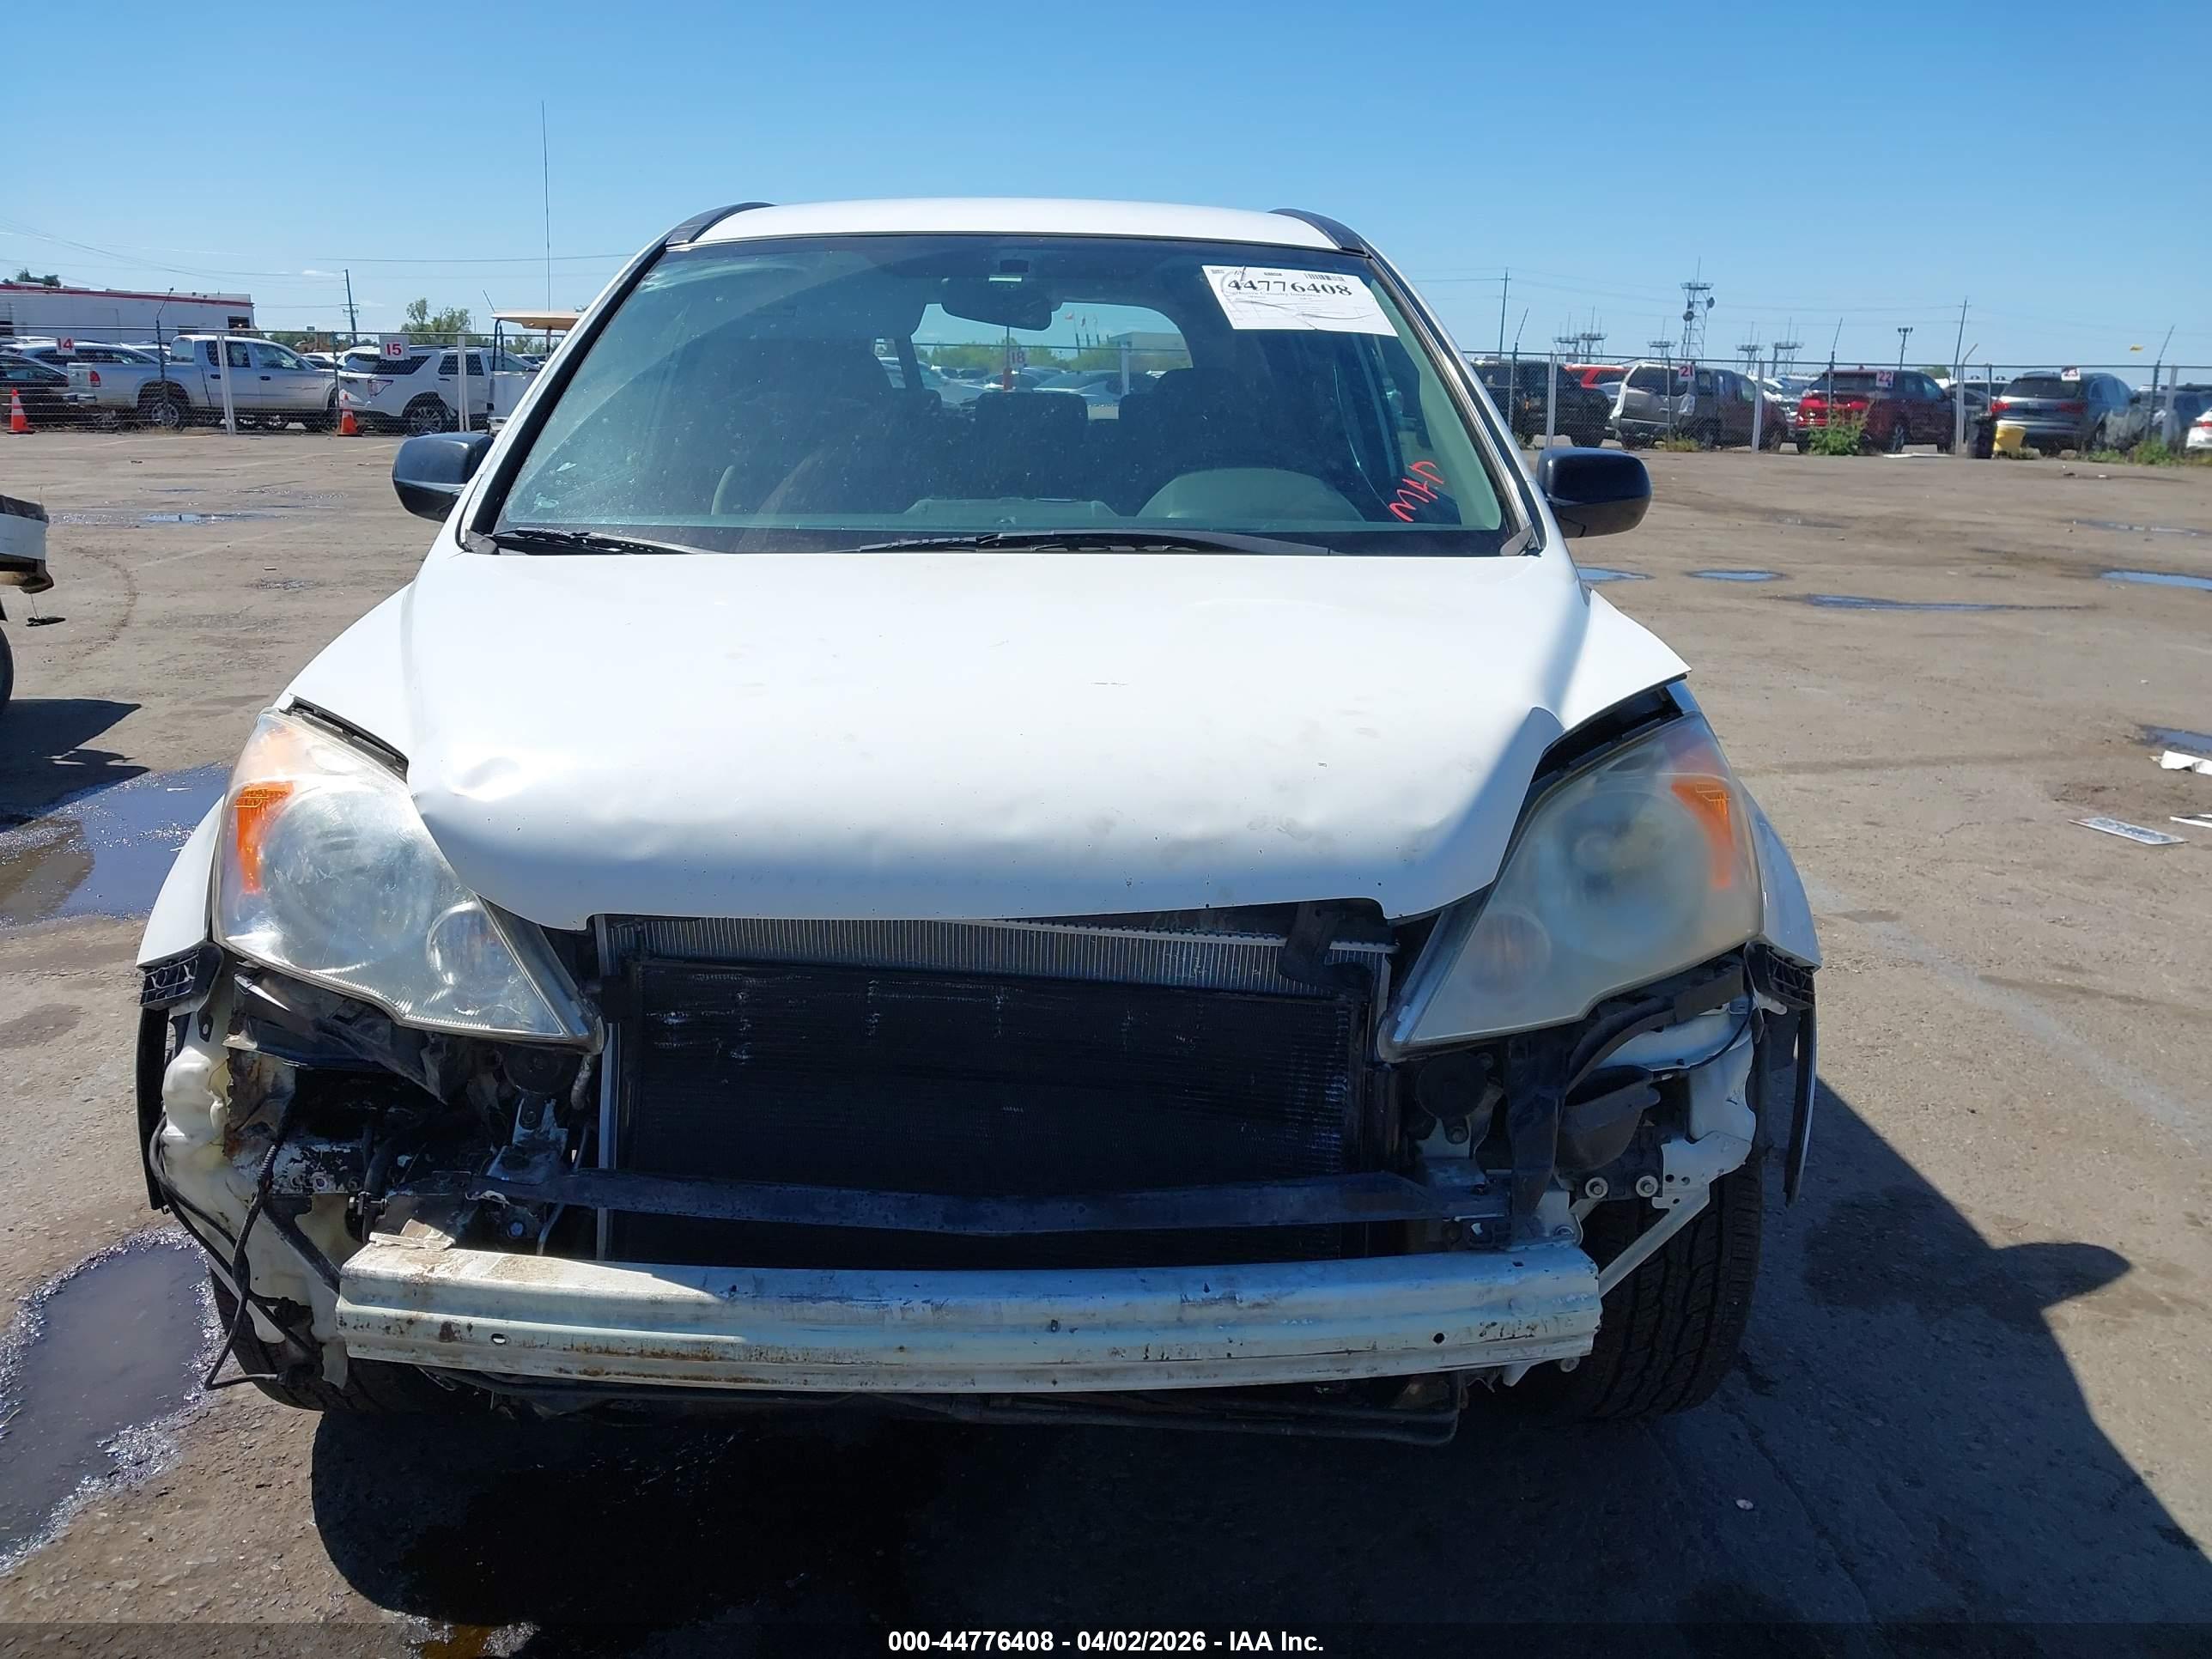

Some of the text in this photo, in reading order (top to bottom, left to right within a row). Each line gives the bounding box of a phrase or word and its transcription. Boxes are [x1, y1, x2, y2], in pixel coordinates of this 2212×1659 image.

[1228, 279, 1353, 296] 44776408
[57, 337, 73, 350] 14
[386, 343, 402, 356] 15
[1680, 365, 1693, 377] 21
[1879, 371, 1892, 382] 22
